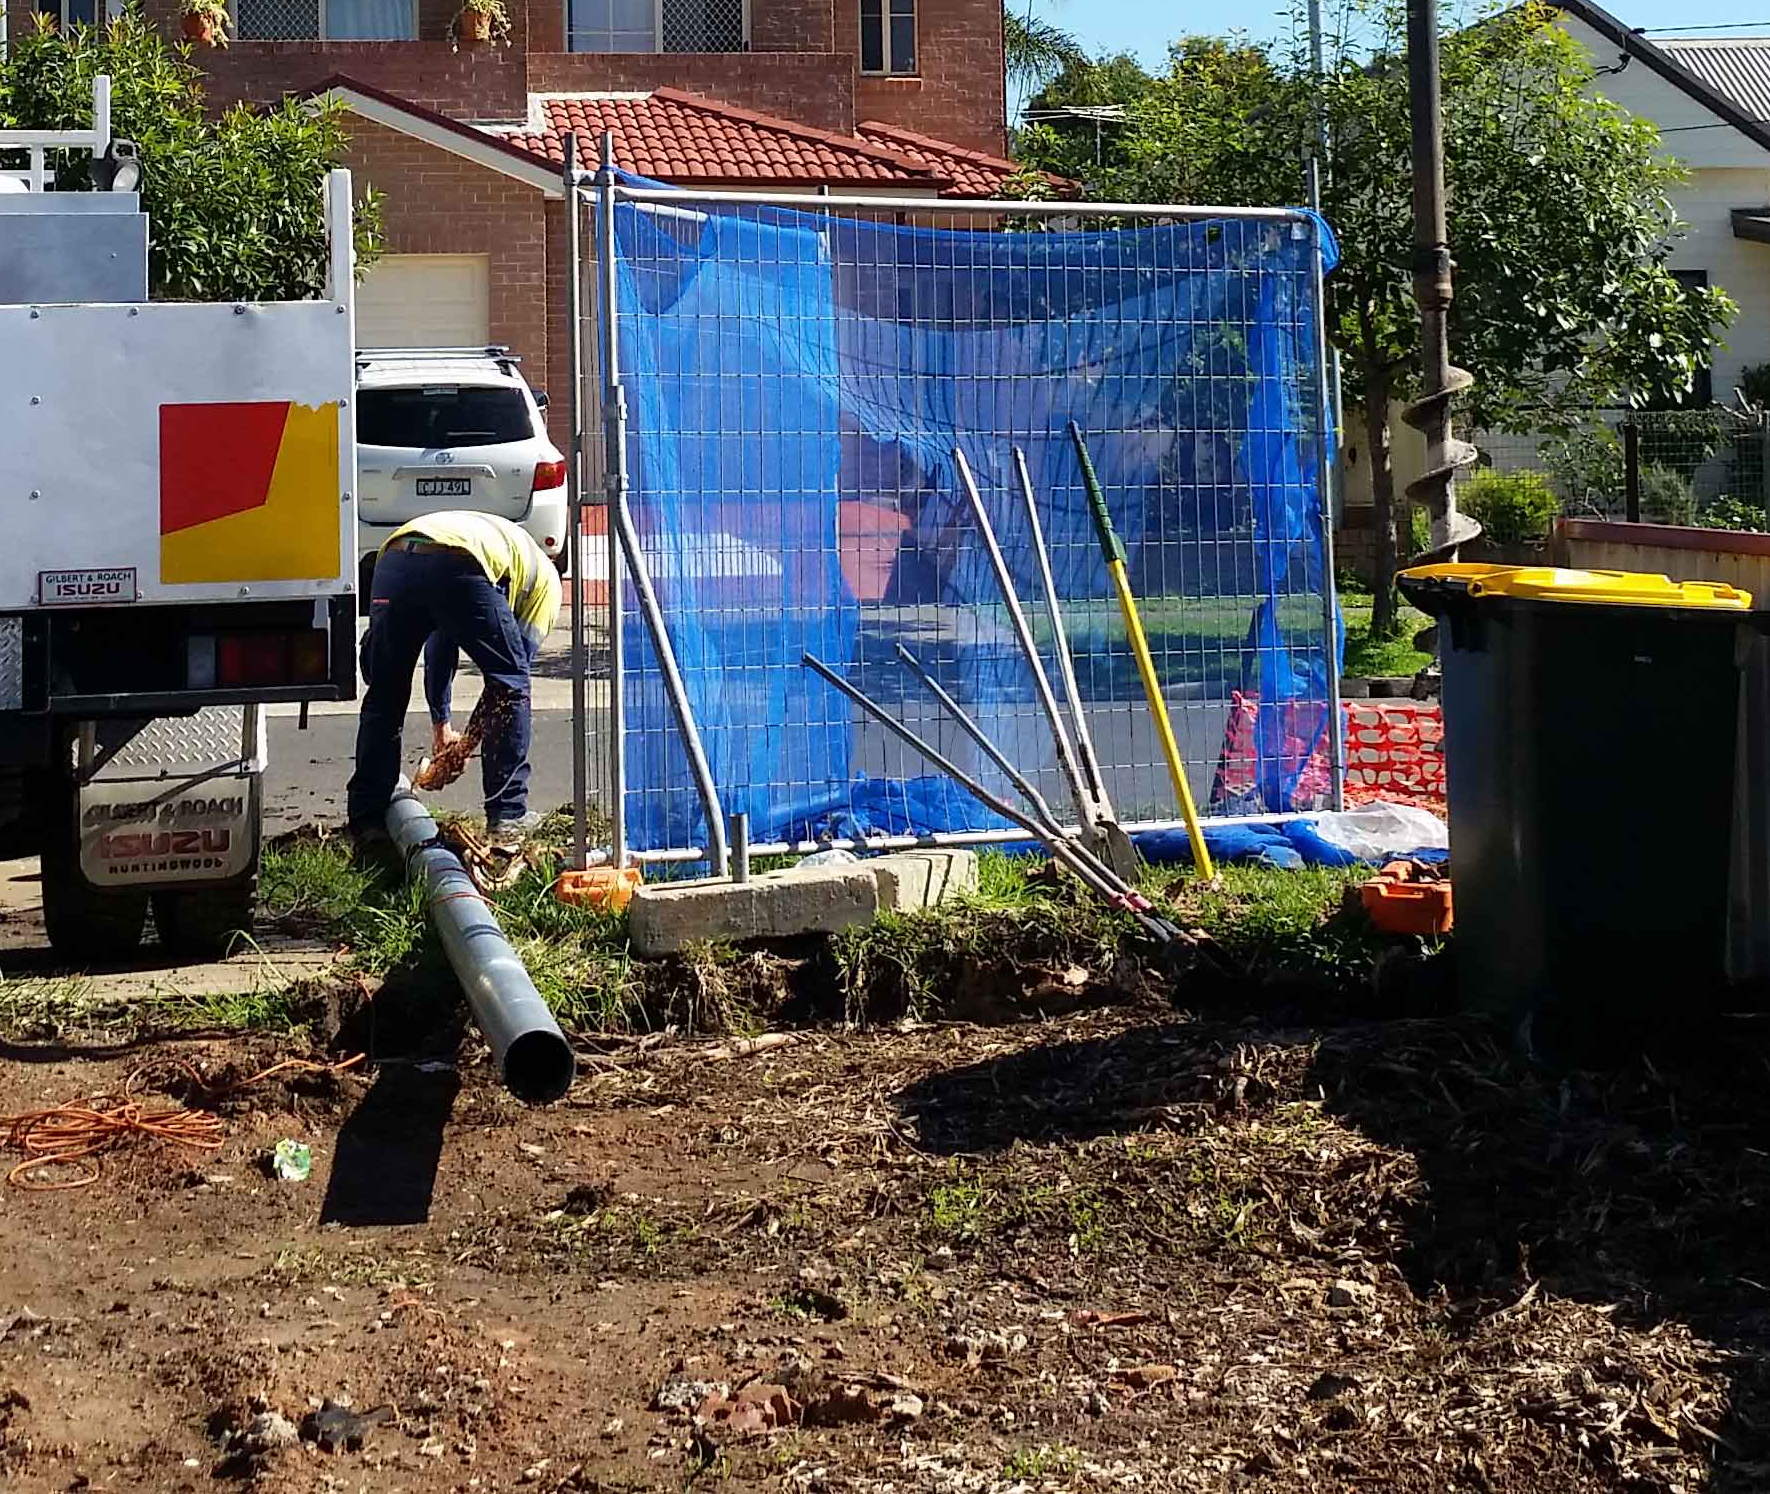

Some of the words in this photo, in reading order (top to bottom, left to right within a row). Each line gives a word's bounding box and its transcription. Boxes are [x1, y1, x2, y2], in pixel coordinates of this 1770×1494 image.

[45, 574, 84, 584] GILBERT
[97, 572, 131, 581] ROACH
[56, 583, 120, 596] ISUZU
[99, 829, 230, 858] ISUZU
